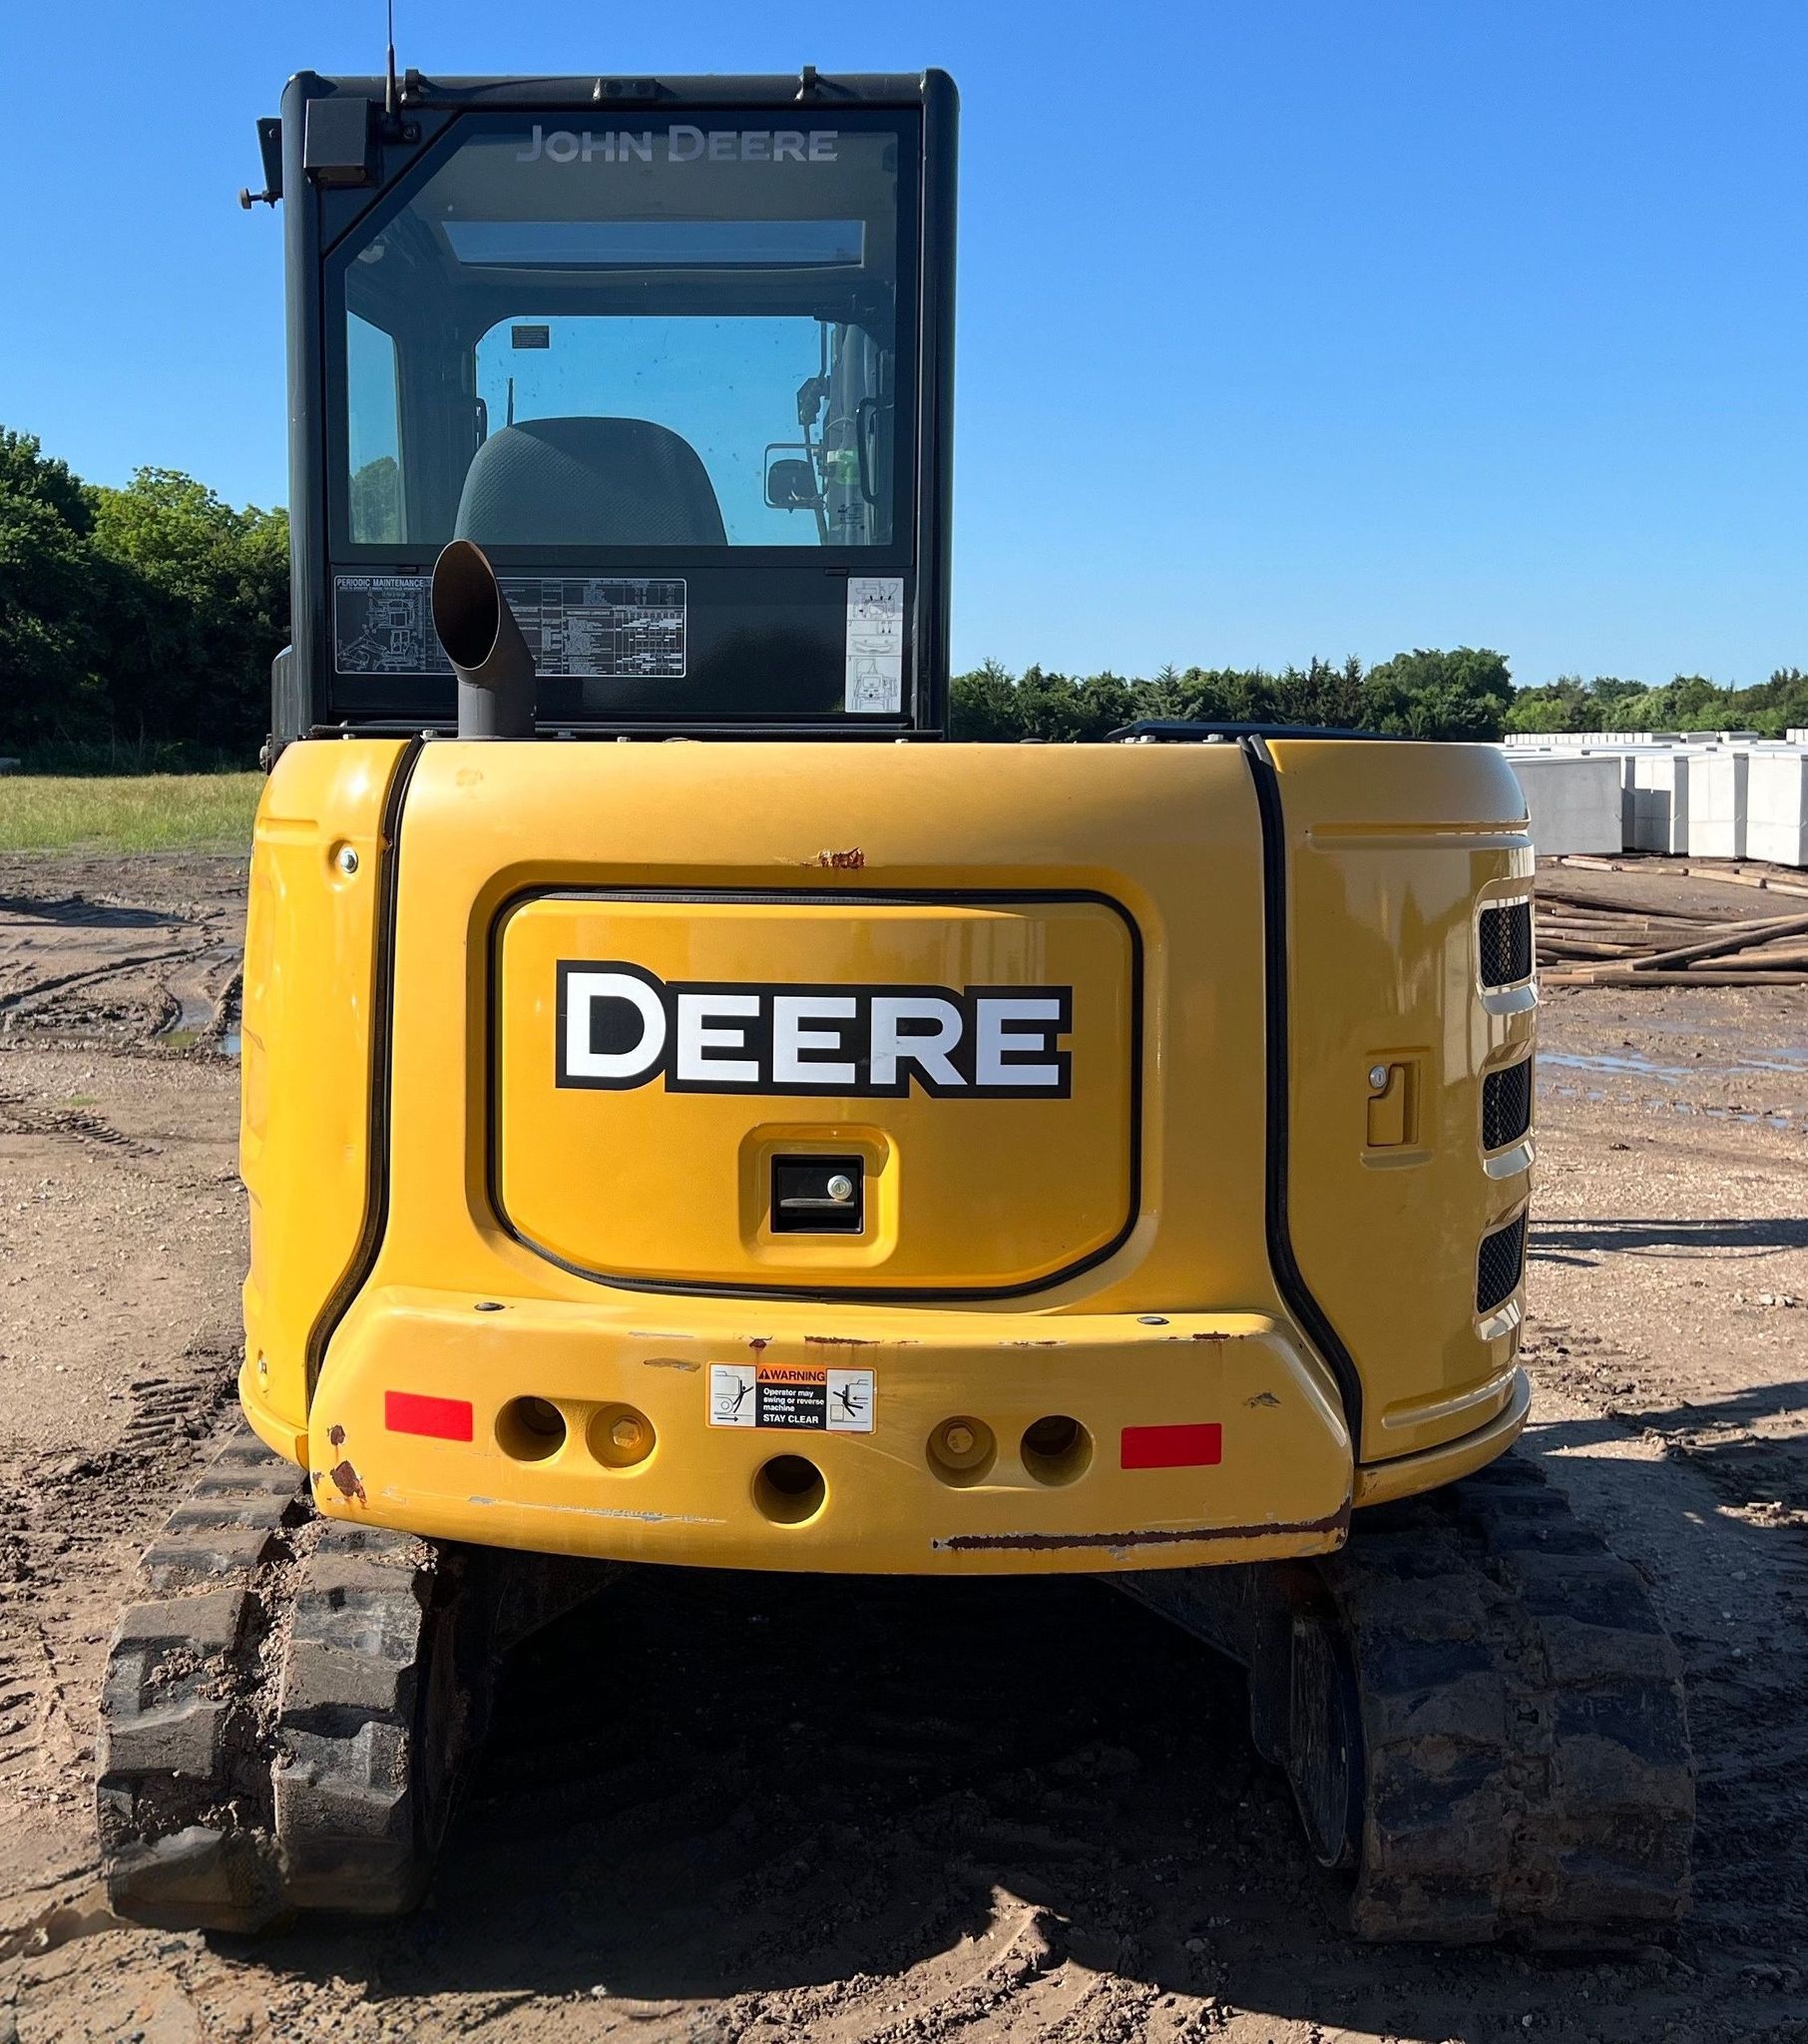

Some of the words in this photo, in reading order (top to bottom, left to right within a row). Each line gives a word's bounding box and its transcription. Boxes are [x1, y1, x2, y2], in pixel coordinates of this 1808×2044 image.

[516, 125, 653, 163] JOHN
[669, 125, 839, 163] DEERE
[336, 578, 371, 587] PERIODIC
[372, 579, 424, 588] MAINTENANCE
[564, 970, 1061, 1087] DEERE
[770, 1369, 825, 1382] WARNING
[763, 1387, 797, 1396] Operator
[763, 1396, 786, 1405] swing
[763, 1413, 786, 1423] STAY
[787, 1414, 819, 1424] CLEAR
